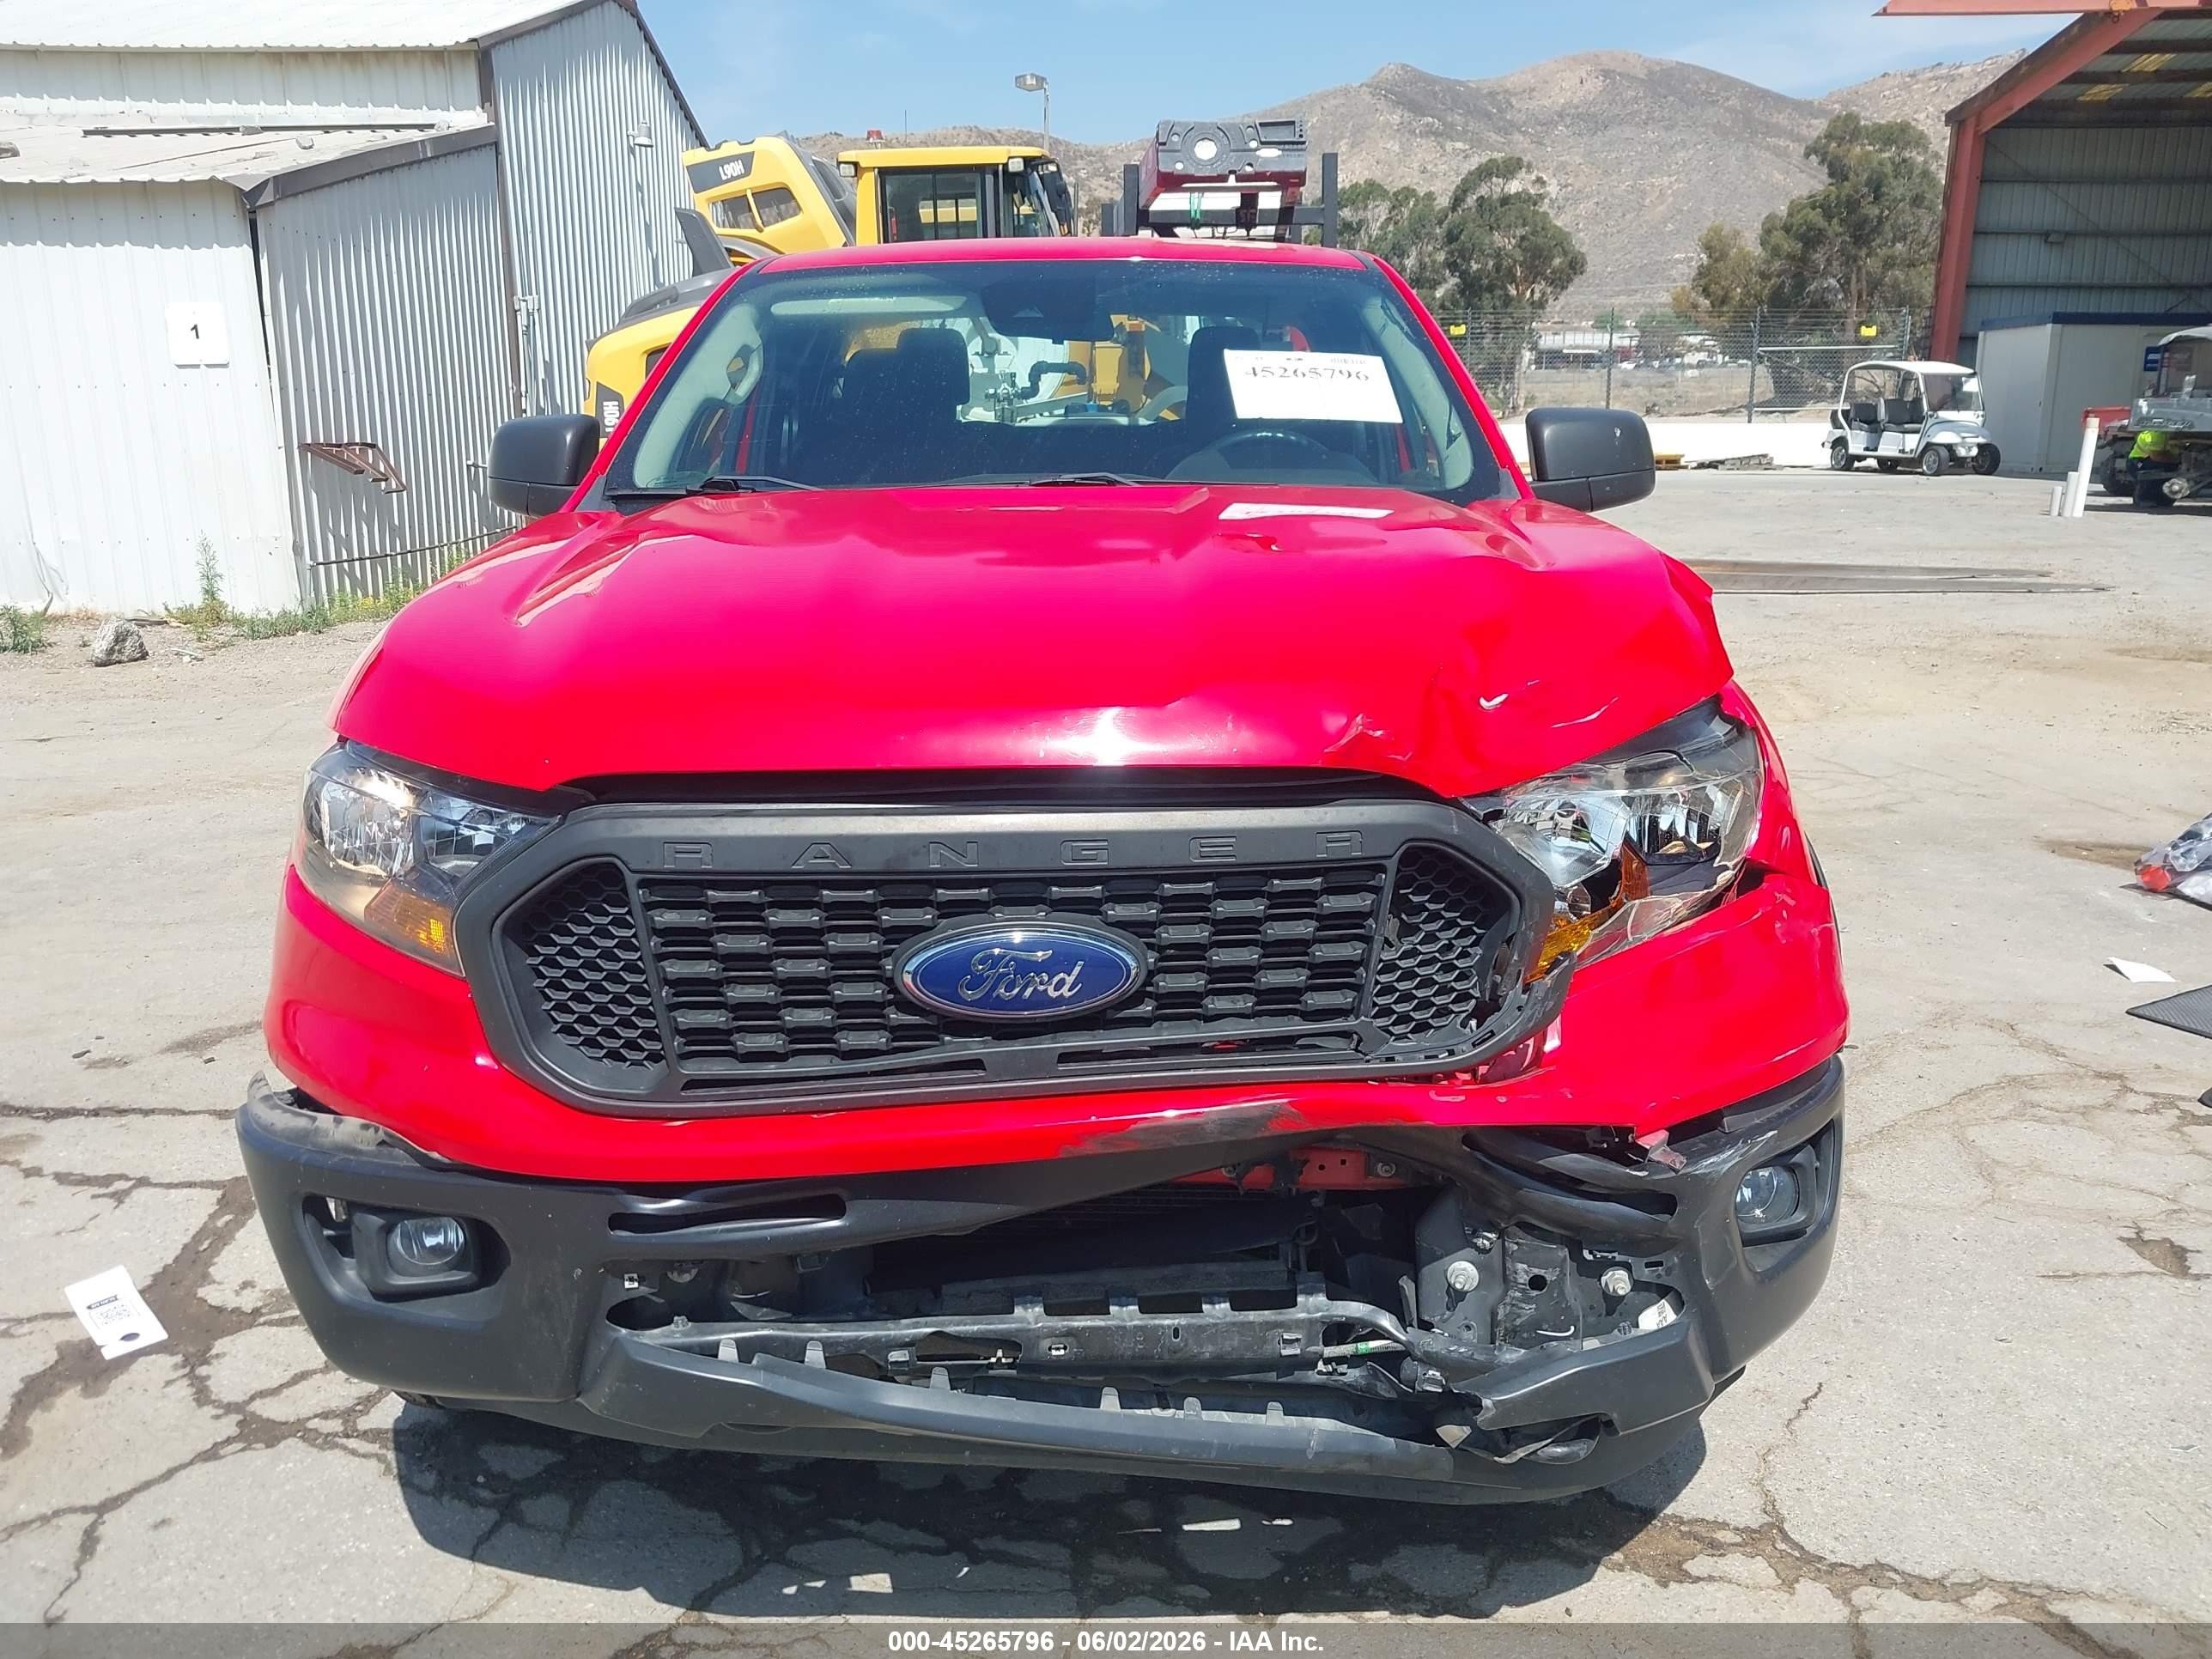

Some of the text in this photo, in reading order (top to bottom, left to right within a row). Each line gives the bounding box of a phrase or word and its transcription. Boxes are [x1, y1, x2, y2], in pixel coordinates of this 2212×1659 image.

[719, 159, 745, 181] L90H
[190, 324, 200, 340] 1
[1244, 366, 1370, 381] 45265796
[663, 830, 1364, 868] RANGER
[957, 949, 1085, 1002] Ford
